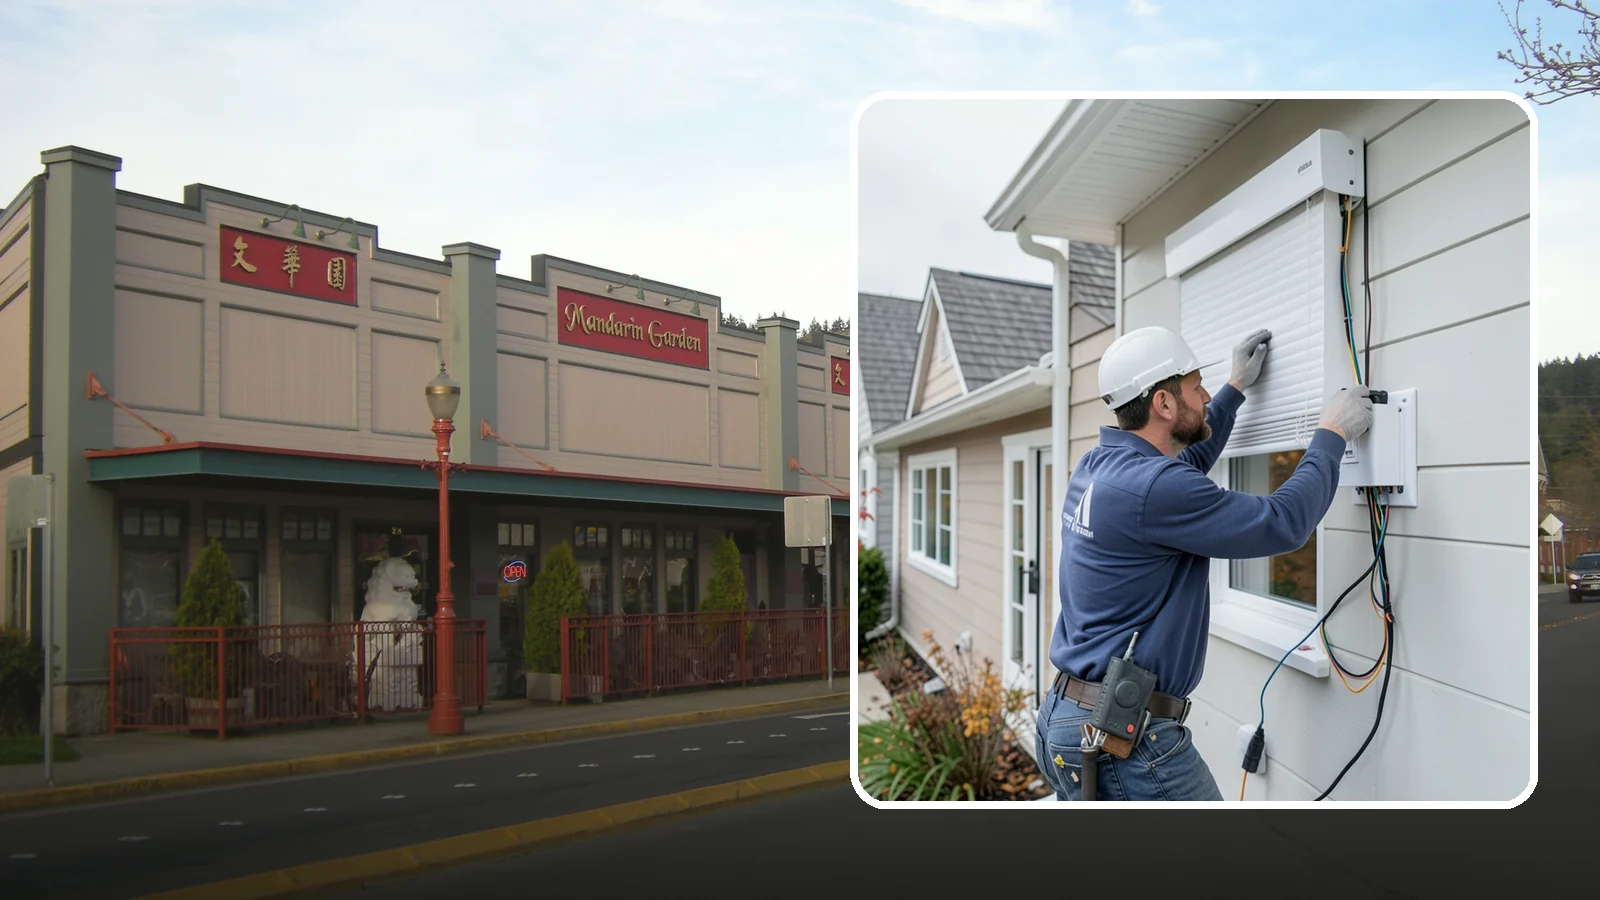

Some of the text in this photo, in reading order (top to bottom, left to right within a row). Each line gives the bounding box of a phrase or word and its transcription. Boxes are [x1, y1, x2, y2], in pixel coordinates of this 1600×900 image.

[231, 235, 346, 291] 文華園
[564, 302, 702, 352] Mandarin Garden
[503, 565, 527, 578] OPEN
